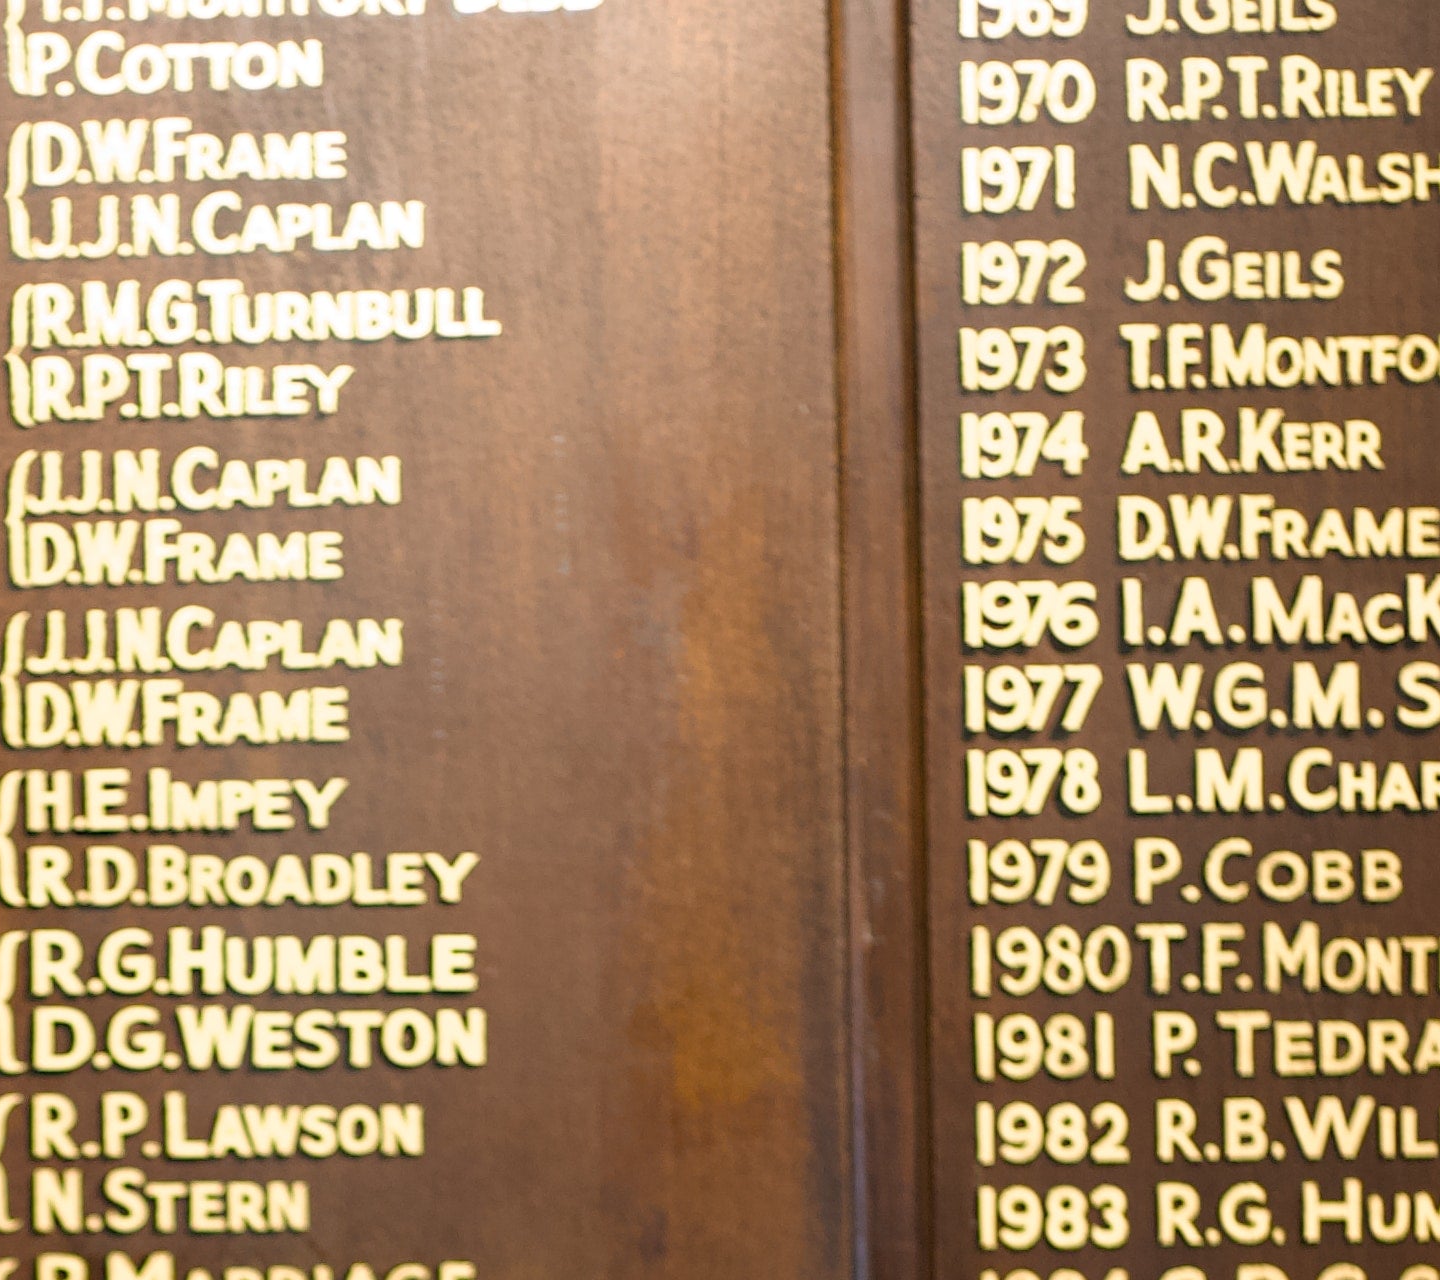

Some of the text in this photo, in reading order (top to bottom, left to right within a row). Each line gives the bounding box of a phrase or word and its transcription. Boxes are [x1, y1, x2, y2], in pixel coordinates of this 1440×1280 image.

[960, 59, 1096, 125] 1970
[962, 144, 1075, 213] 1971
[962, 239, 1086, 305] 1972
[959, 326, 1086, 391] 1973
[962, 411, 1088, 478] 1974
[963, 496, 1084, 564] 1975
[964, 580, 1099, 647] 1976
[965, 664, 1102, 732] 1977
[968, 748, 1101, 816] 1978
[969, 839, 1110, 904] 1979
[973, 925, 1131, 995] 1980
[976, 1013, 1114, 1079] 1981
[977, 1102, 1129, 1164] 1982
[979, 1185, 1128, 1249] 1983
